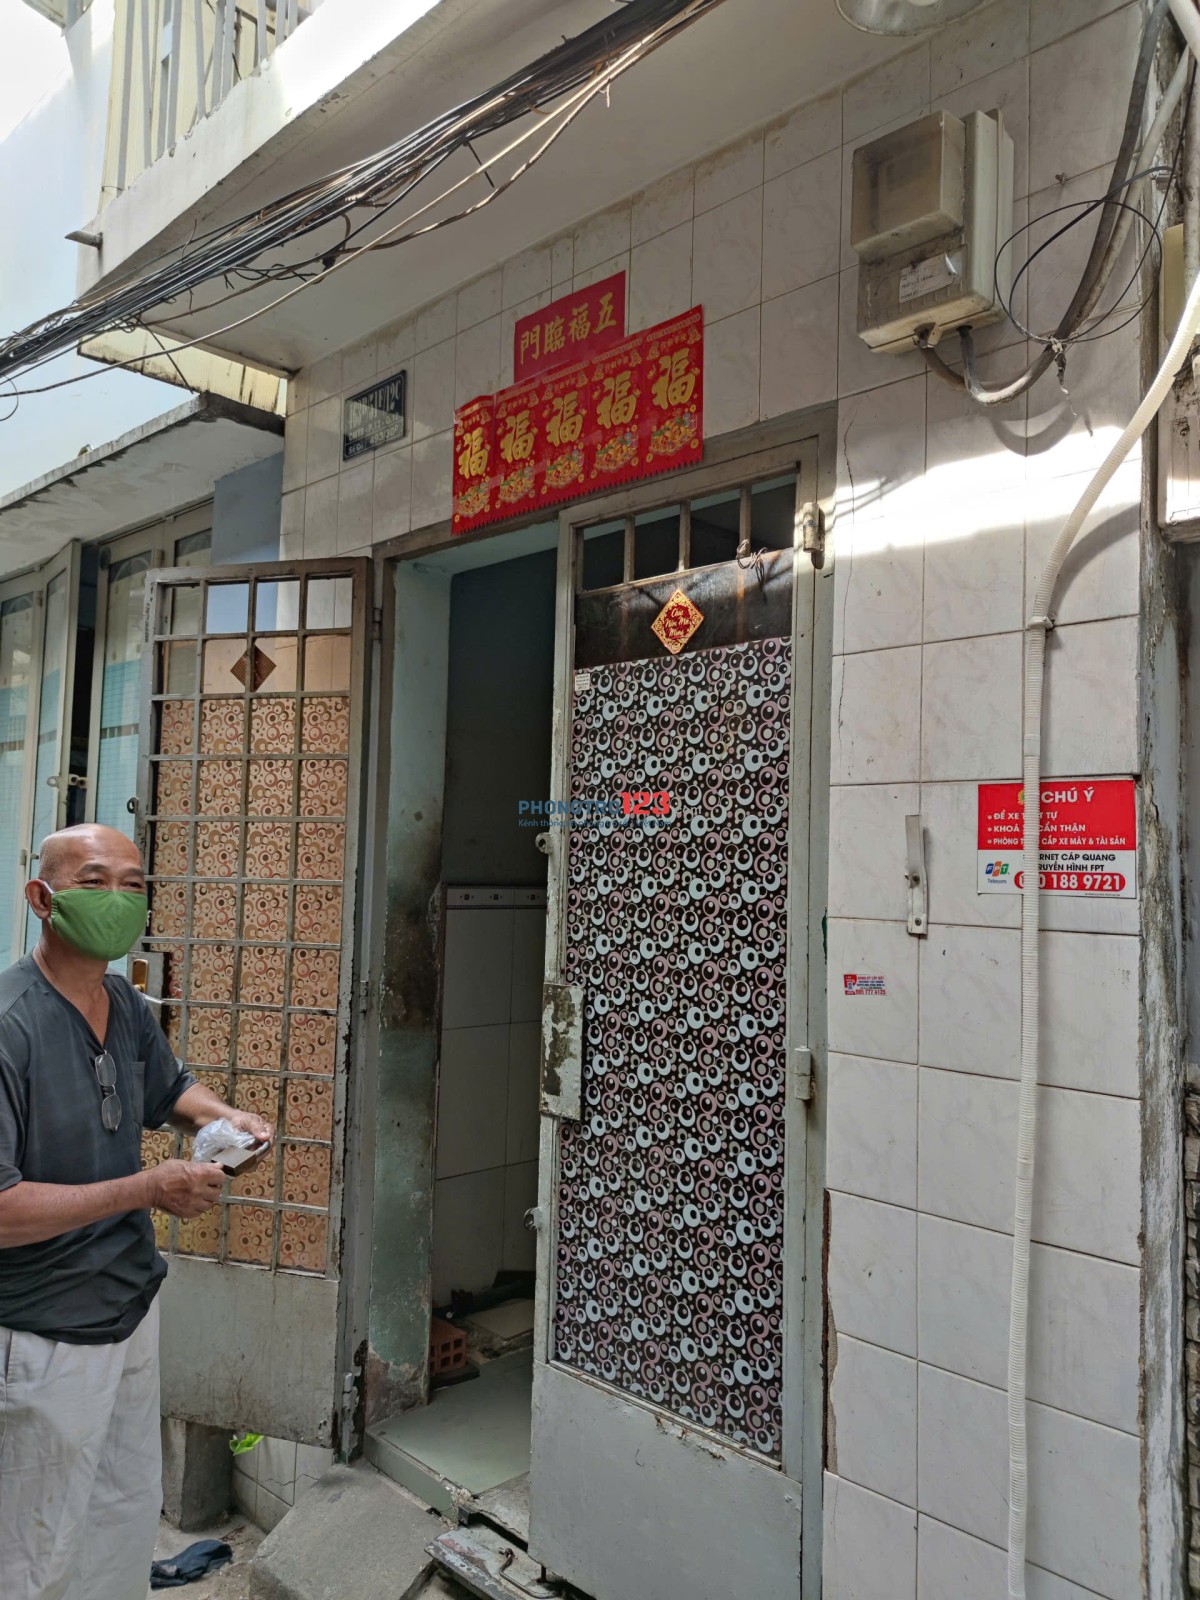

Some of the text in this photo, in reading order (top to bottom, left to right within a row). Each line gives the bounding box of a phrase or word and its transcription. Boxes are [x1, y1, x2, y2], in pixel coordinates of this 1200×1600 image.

[652, 348, 696, 410] 福
[597, 370, 637, 429] 福
[546, 391, 583, 447] 福
[500, 410, 535, 464] 福
[458, 427, 489, 479] 福
[1041, 786, 1095, 803] CHÚ Ý
[1008, 812, 1020, 820] XE
[1046, 810, 1058, 821] TỰ
[994, 823, 1020, 832] KHOÁ
[1060, 822, 1086, 833] THẬN
[993, 836, 1019, 845] PHÒNG
[1059, 837, 1068, 845] XE
[1070, 836, 1087, 845] MÁY
[1088, 837, 1094, 845] &
[1095, 836, 1108, 845] TÀI
[1061, 852, 1080, 861] CÁP
[1082, 853, 1116, 862] QUANG
[985, 861, 1010, 877] FPT
[1066, 862, 1088, 872] HÌNH
[1051, 873, 1078, 889] 188
[1083, 874, 1120, 890] 9721
